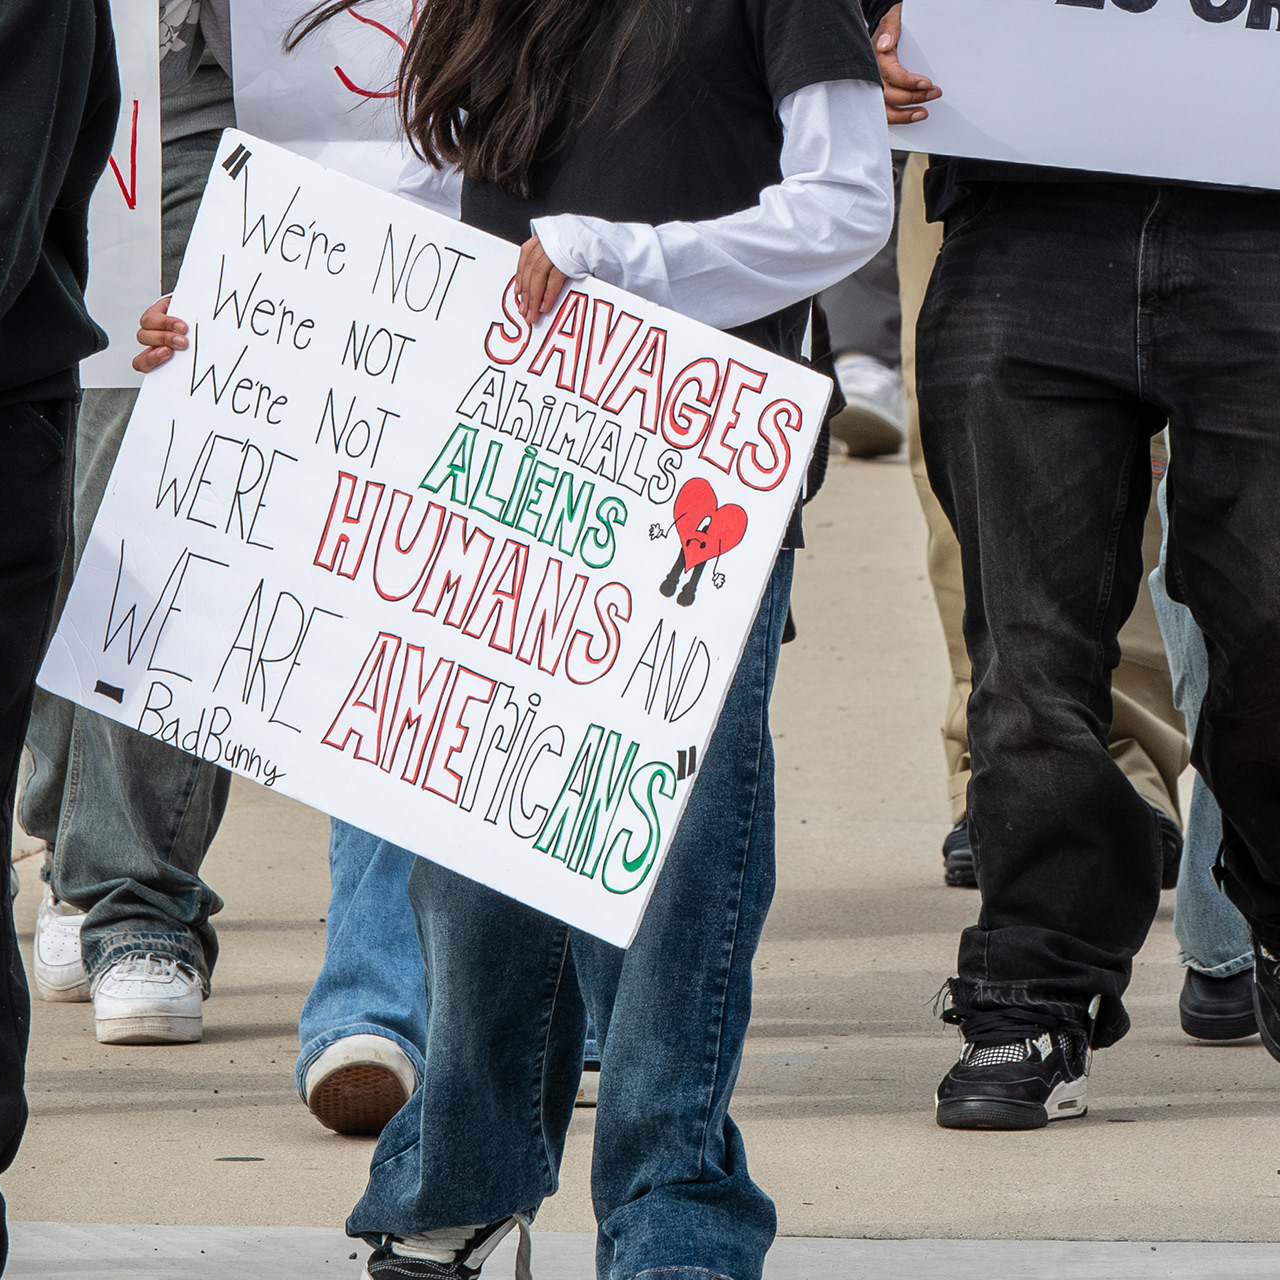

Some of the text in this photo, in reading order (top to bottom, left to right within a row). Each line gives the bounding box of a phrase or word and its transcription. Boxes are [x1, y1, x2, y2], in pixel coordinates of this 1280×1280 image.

[190, 322, 288, 425] We're
[213, 253, 315, 350] We're
[342, 320, 417, 384] NOT
[372, 223, 476, 321] NOT
[484, 275, 804, 492] SAVAGES
[103, 538, 230, 683] WE
[212, 577, 347, 733] ARE
[313, 470, 632, 686] HUMANS
[620, 618, 711, 724] AND
